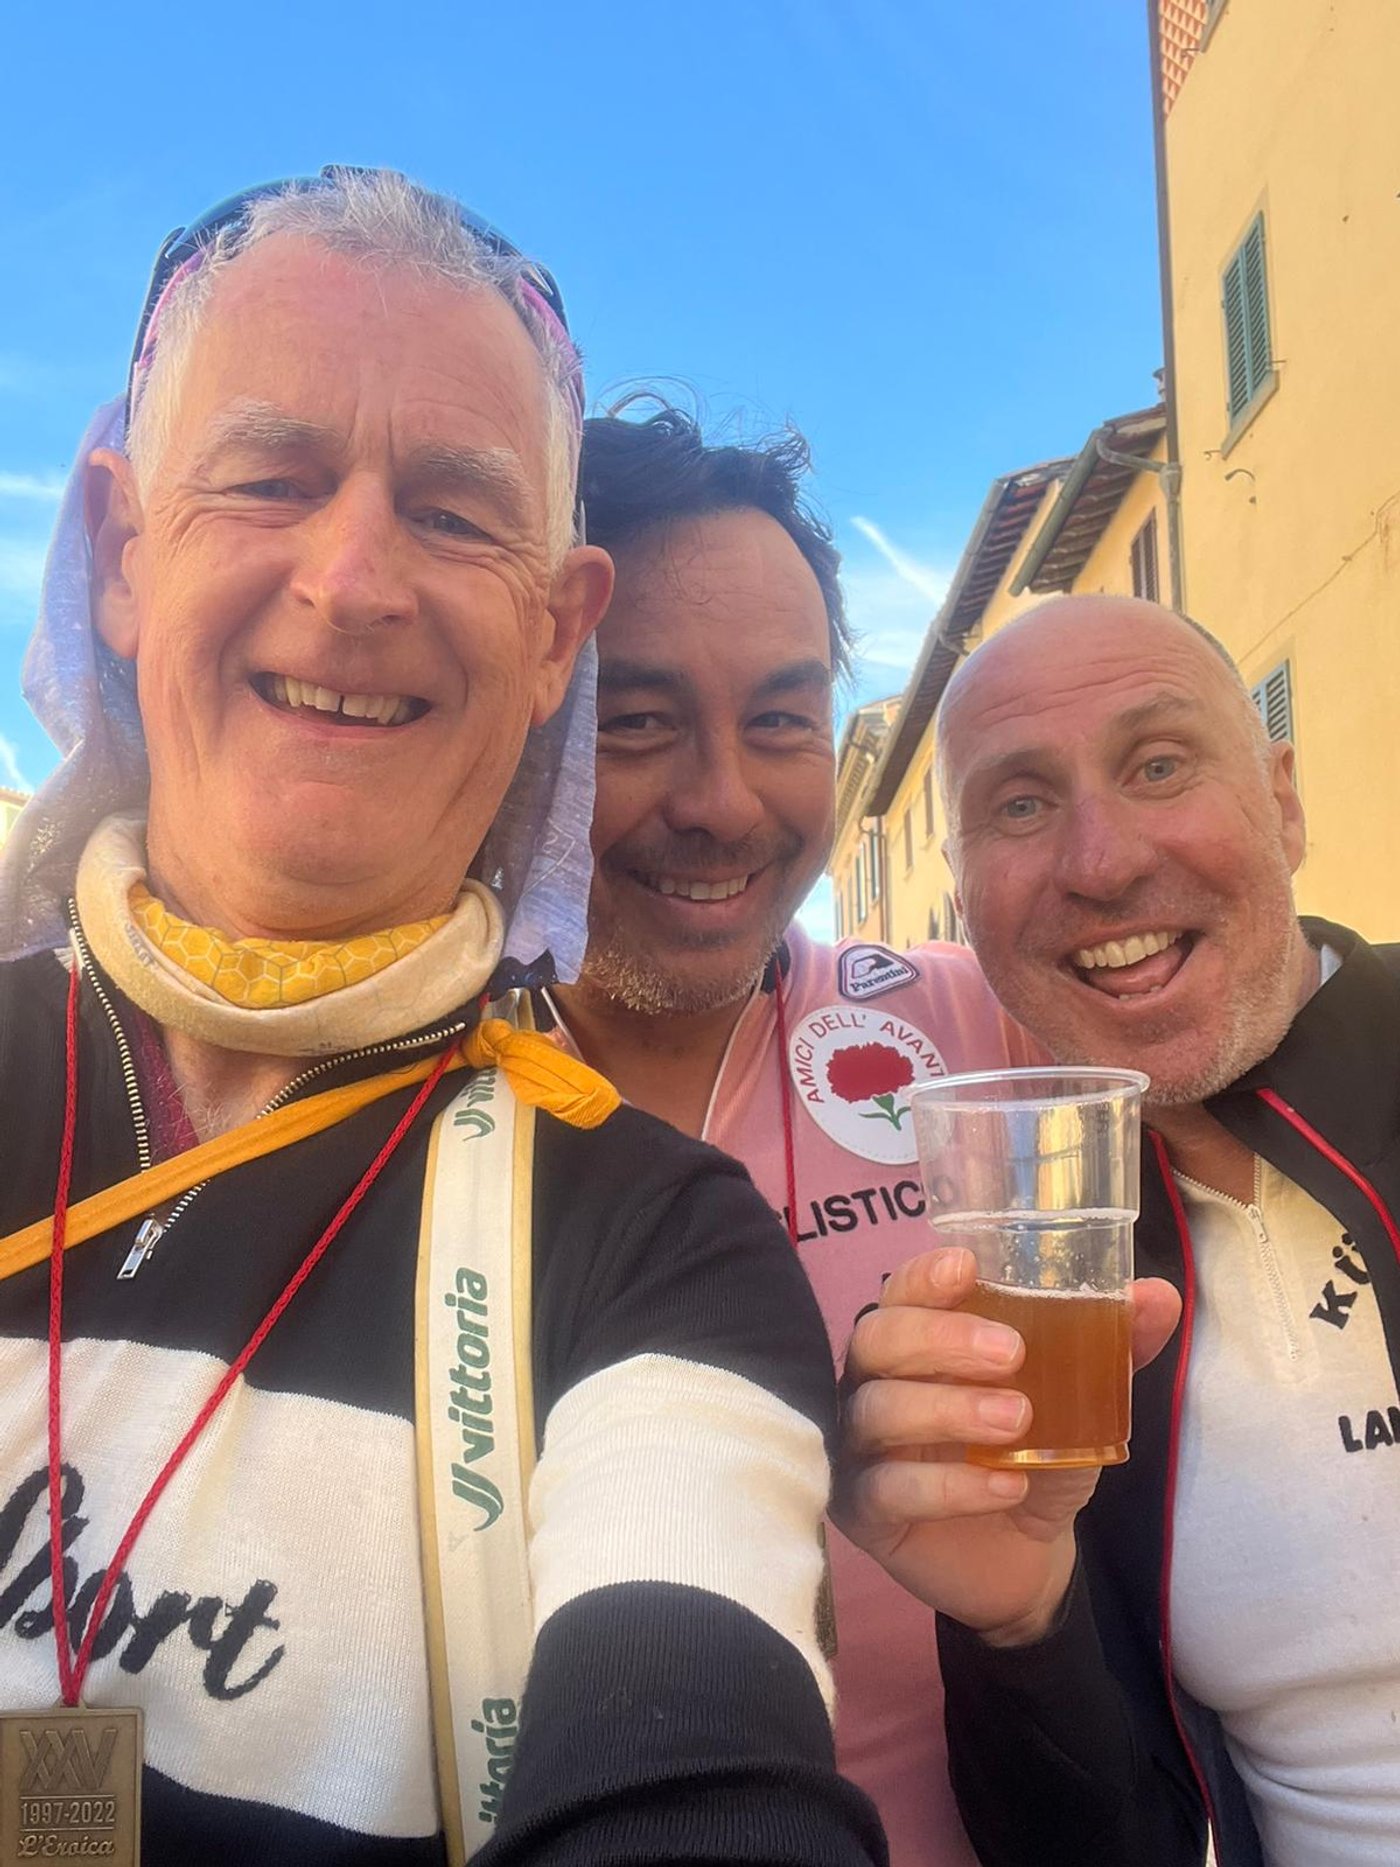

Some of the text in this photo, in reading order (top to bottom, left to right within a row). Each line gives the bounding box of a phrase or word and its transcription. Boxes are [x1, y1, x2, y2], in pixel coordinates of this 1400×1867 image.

[849, 967, 909, 993] Parentini
[808, 1013, 867, 1039] DELL'
[795, 1037, 825, 1104] AMICI
[775, 1180, 926, 1243] LISTIC
[444, 1267, 495, 1463] vittoria
[19, 1728, 118, 1789] XXV
[20, 1801, 115, 1825] 1997-2022
[17, 1834, 115, 1858] L'Eroica
